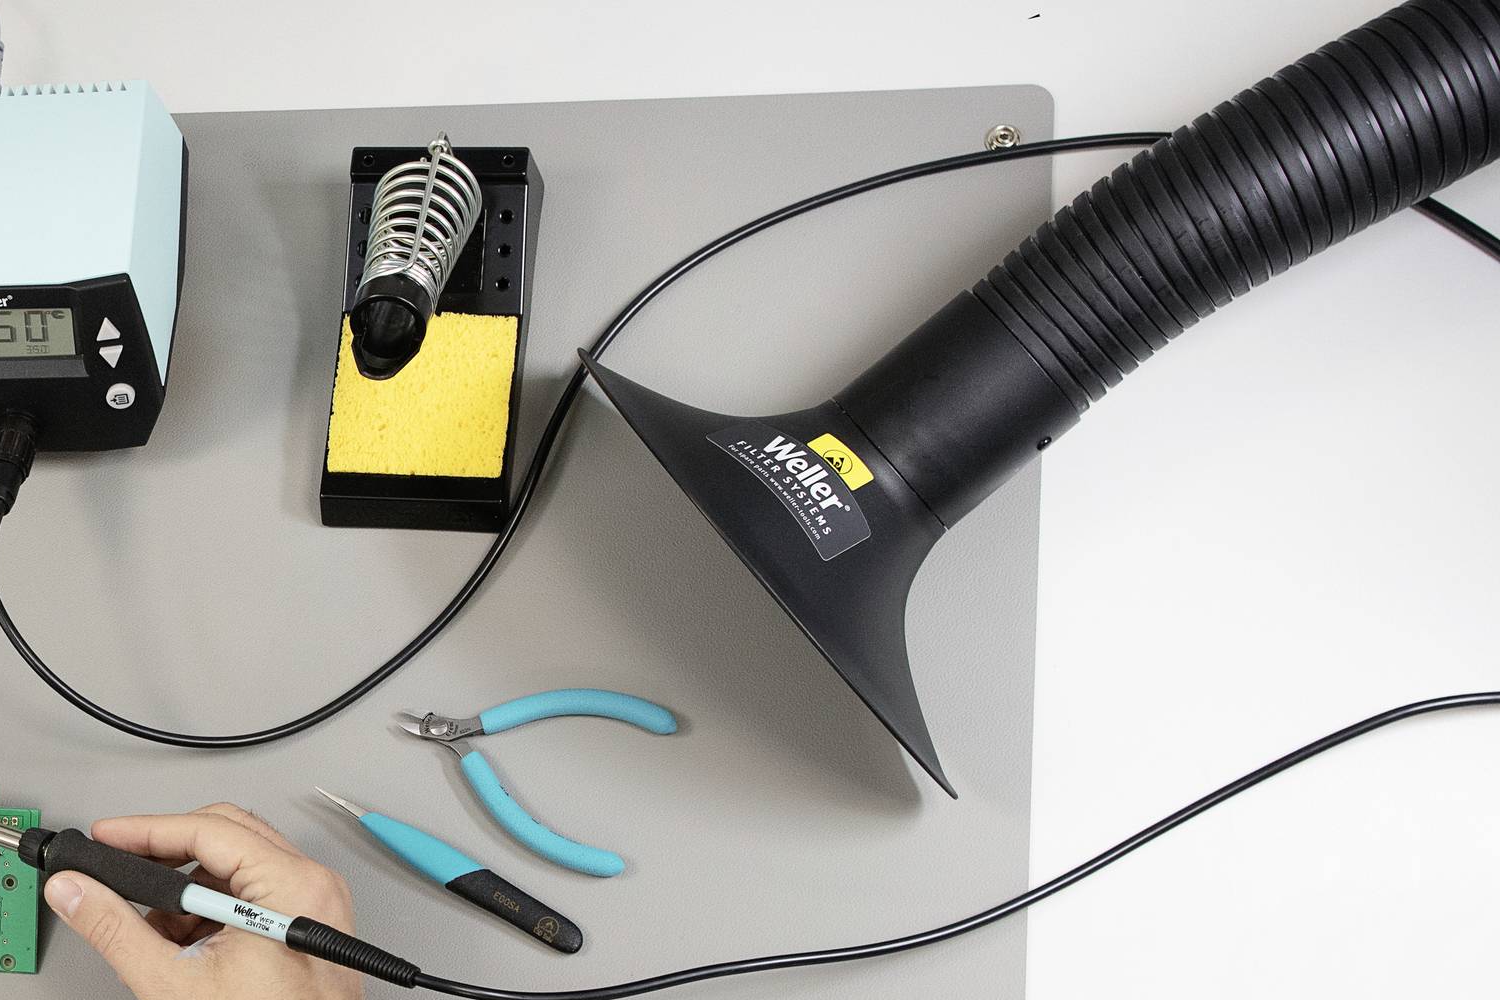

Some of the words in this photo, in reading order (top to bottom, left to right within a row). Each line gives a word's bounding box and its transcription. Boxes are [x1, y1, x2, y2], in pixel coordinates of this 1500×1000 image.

[26, 345, 49, 354] 350
[728, 444, 739, 453] For
[738, 451, 755, 465] spare
[753, 464, 770, 478] parts
[769, 477, 821, 540] www.weller-tools.com
[736, 440, 781, 473] FILTER
[782, 476, 832, 535] SYSTEMS
